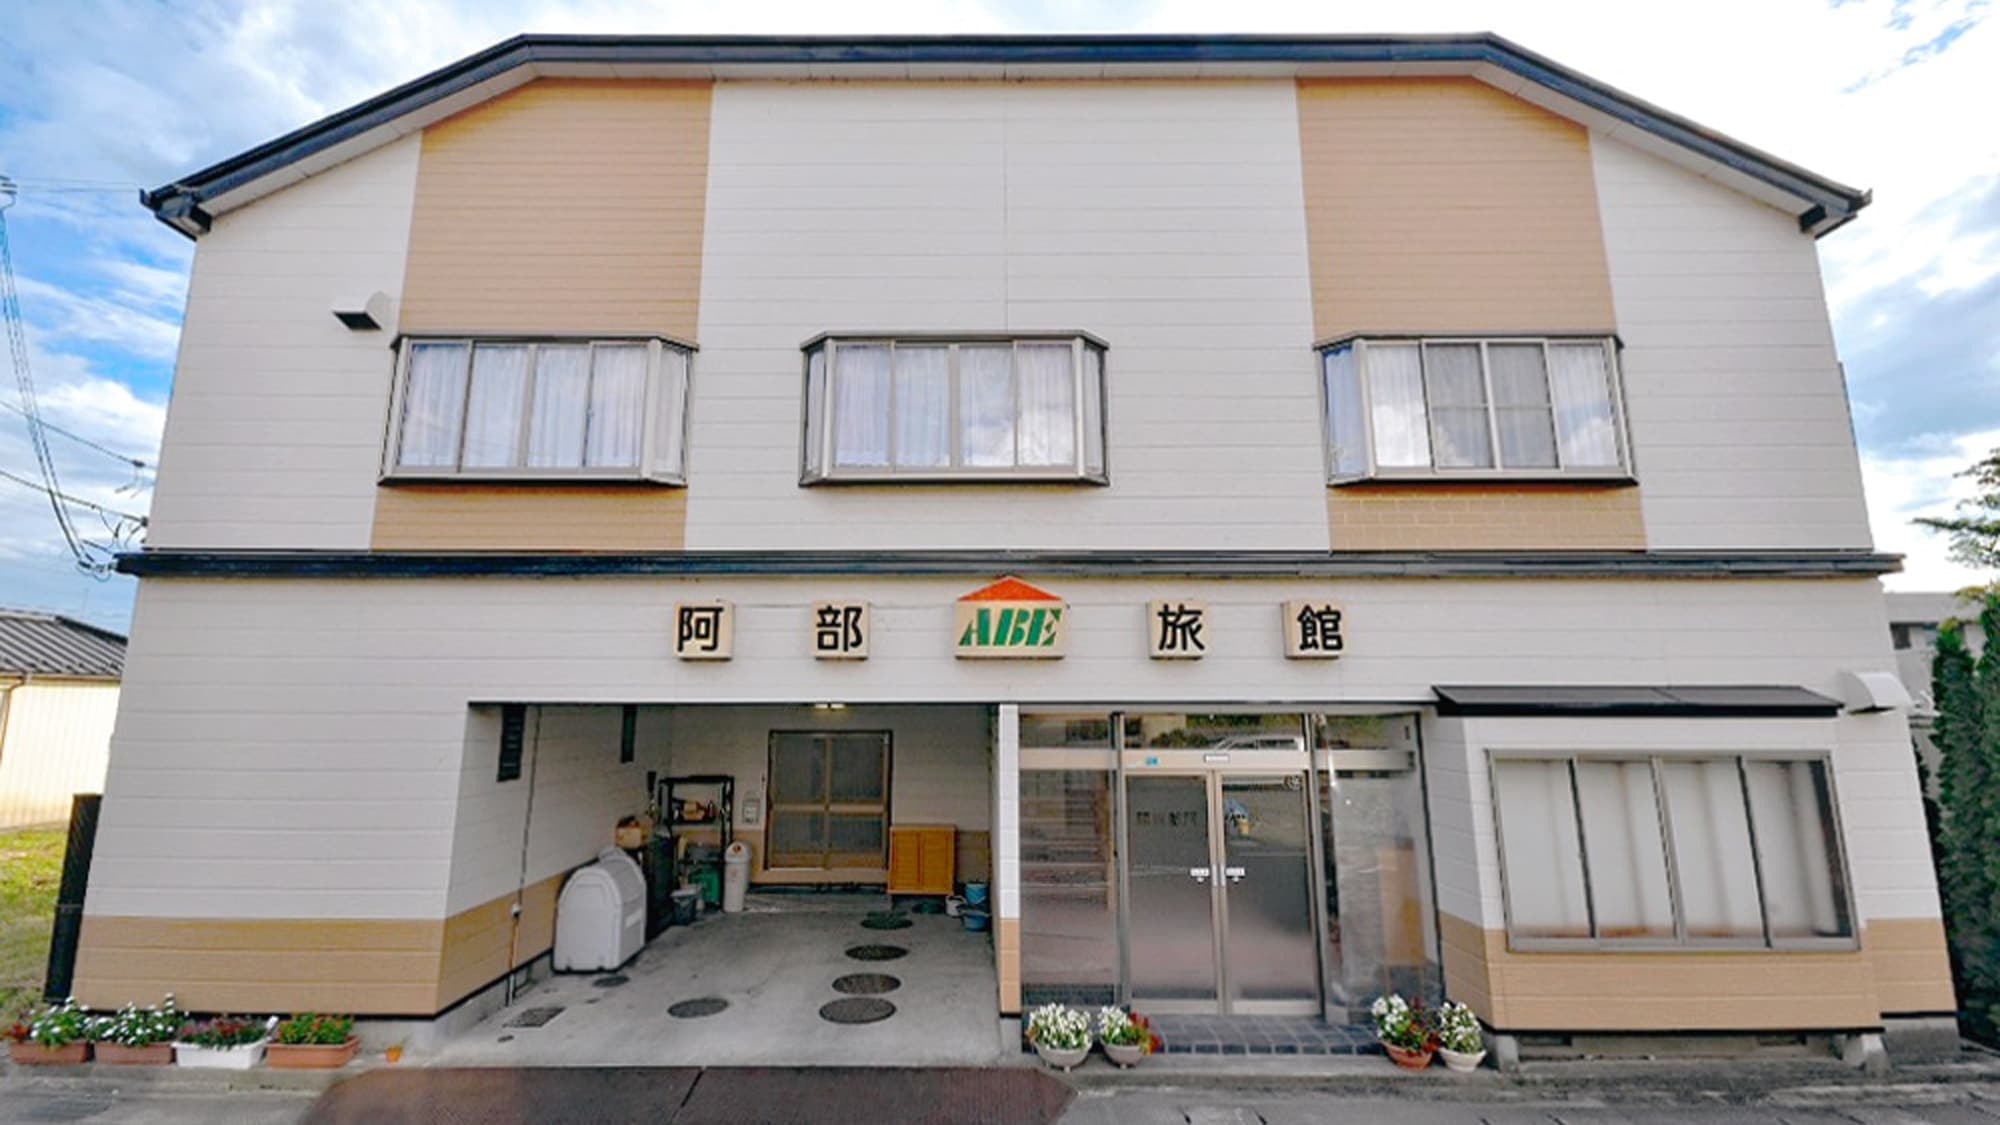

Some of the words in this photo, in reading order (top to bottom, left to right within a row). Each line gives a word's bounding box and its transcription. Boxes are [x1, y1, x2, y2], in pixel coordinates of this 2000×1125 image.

[677, 606, 724, 652] 阿
[815, 605, 863, 651] 部
[959, 606, 1061, 648] ABE
[1157, 604, 1205, 651] 旅
[1297, 604, 1343, 651] 館
